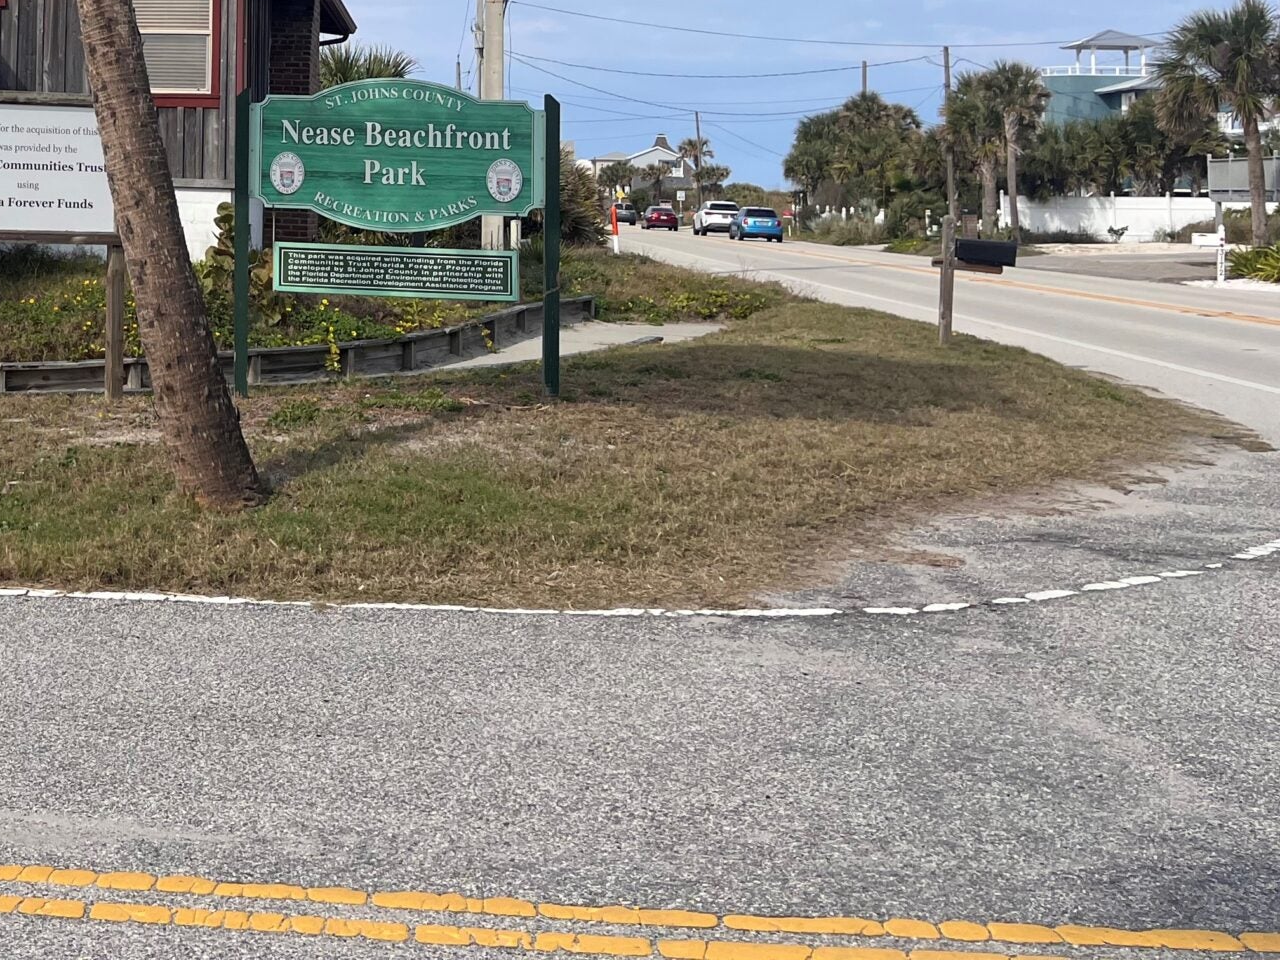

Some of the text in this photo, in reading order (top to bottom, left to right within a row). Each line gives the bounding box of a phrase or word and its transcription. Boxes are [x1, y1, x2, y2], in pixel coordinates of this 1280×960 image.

[325, 87, 466, 112] ST. JOHNS COUNTY
[11, 124, 25, 133] the
[26, 125, 71, 136] acquisition
[72, 127, 81, 135] of
[82, 127, 98, 136] this
[281, 119, 512, 151] Nease Beachfront
[14, 143, 51, 154] provided
[53, 144, 63, 154] by
[64, 145, 78, 154] the
[362, 159, 427, 187] Park
[17, 181, 40, 191] using
[7, 197, 55, 208] Forever
[57, 198, 94, 210] Funds
[313, 191, 478, 224] RECREATION & PARKS
[288, 258, 344, 266] Communities
[445, 264, 483, 272] Program
[403, 257, 435, 265] funding
[330, 271, 374, 279] Department
[385, 274, 441, 282] Environmental
[443, 276, 484, 284] Protection
[333, 265, 344, 273] by
[388, 268, 418, 276] County
[432, 270, 482, 278] partnership
[373, 279, 424, 287] Development
[425, 281, 468, 289] Assistance
[469, 283, 504, 291] Program
